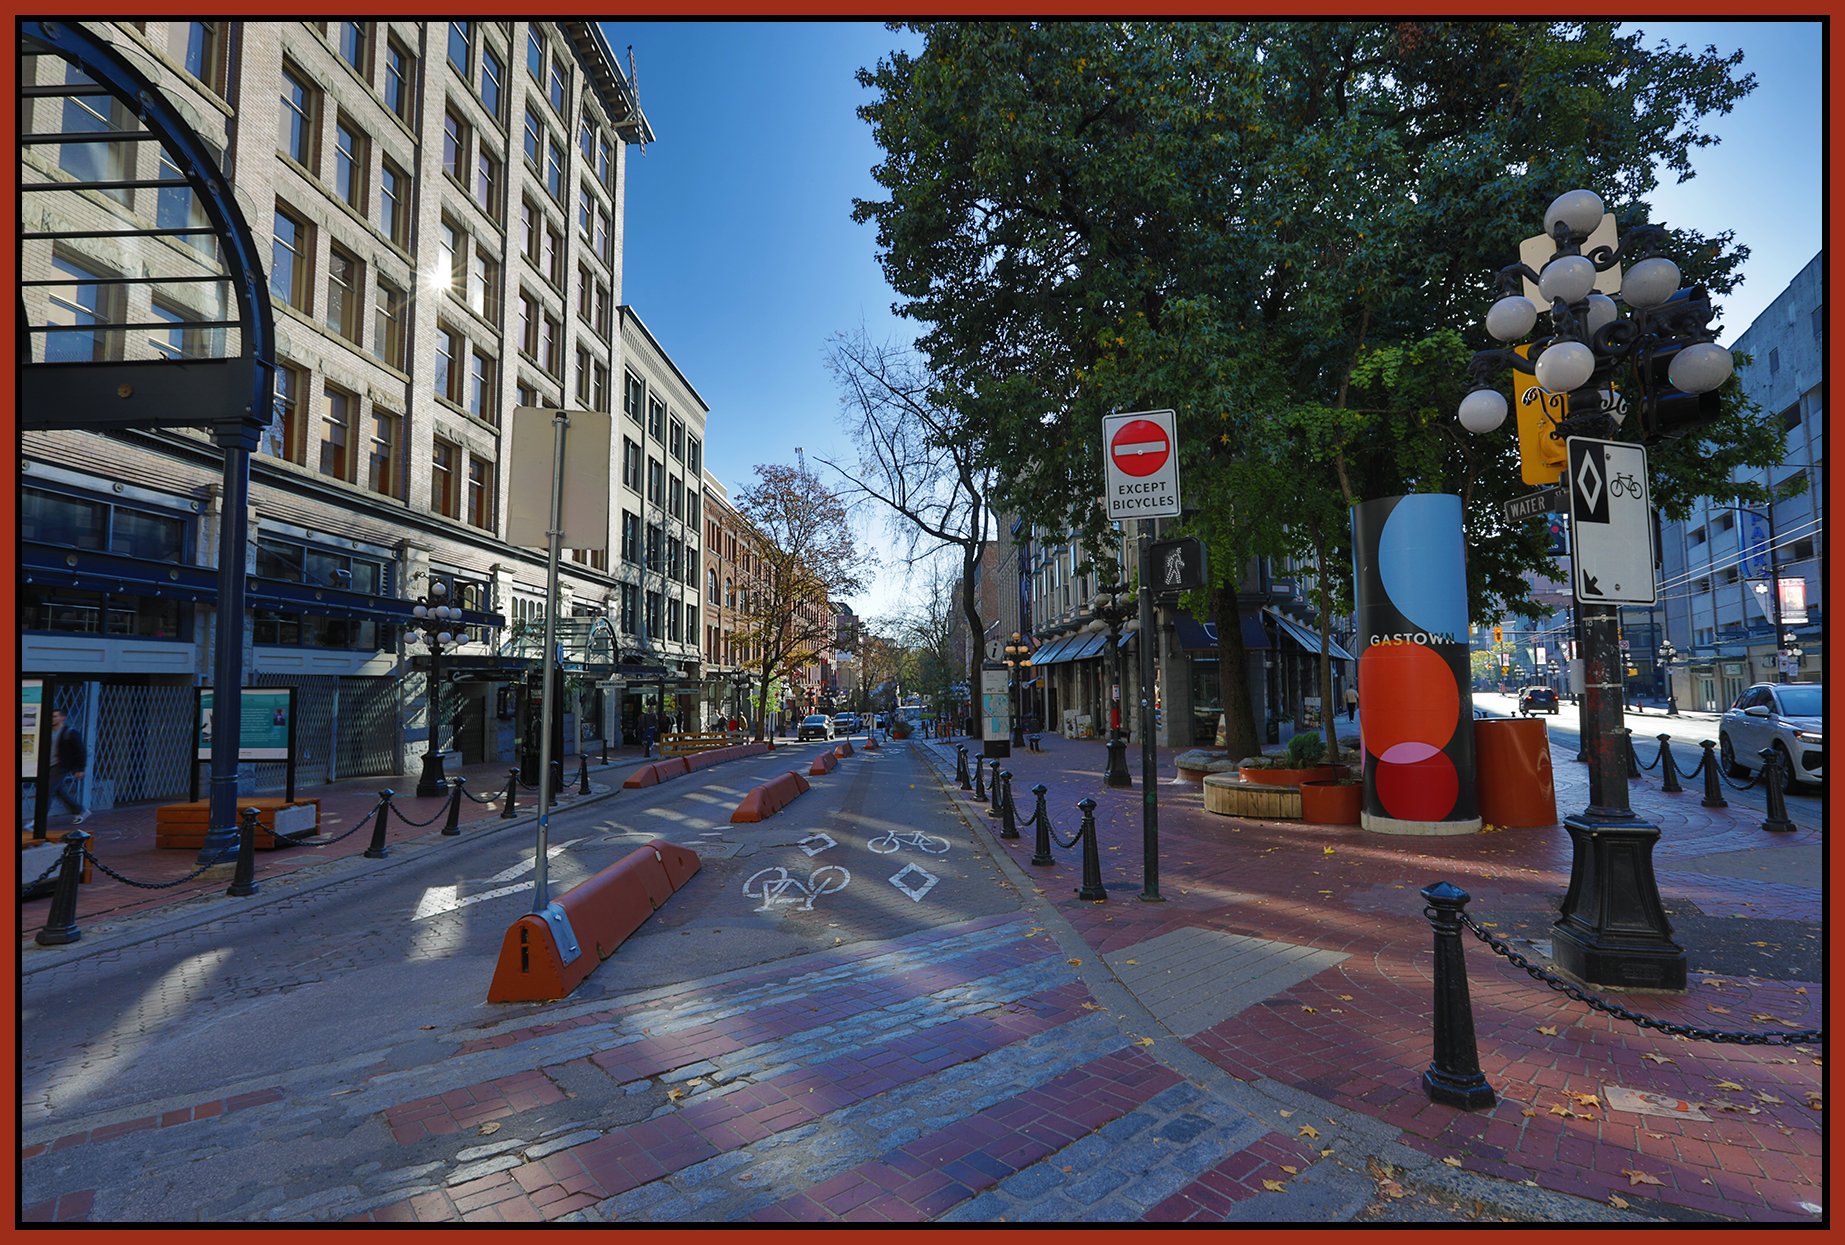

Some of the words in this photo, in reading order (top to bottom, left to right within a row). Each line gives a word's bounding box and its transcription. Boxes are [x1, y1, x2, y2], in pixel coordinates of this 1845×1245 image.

[1119, 481, 1166, 495] EXCEPT
[1113, 496, 1174, 510] BICYCLES
[1510, 496, 1546, 518] WATER
[1370, 632, 1455, 647] GASTOWN
